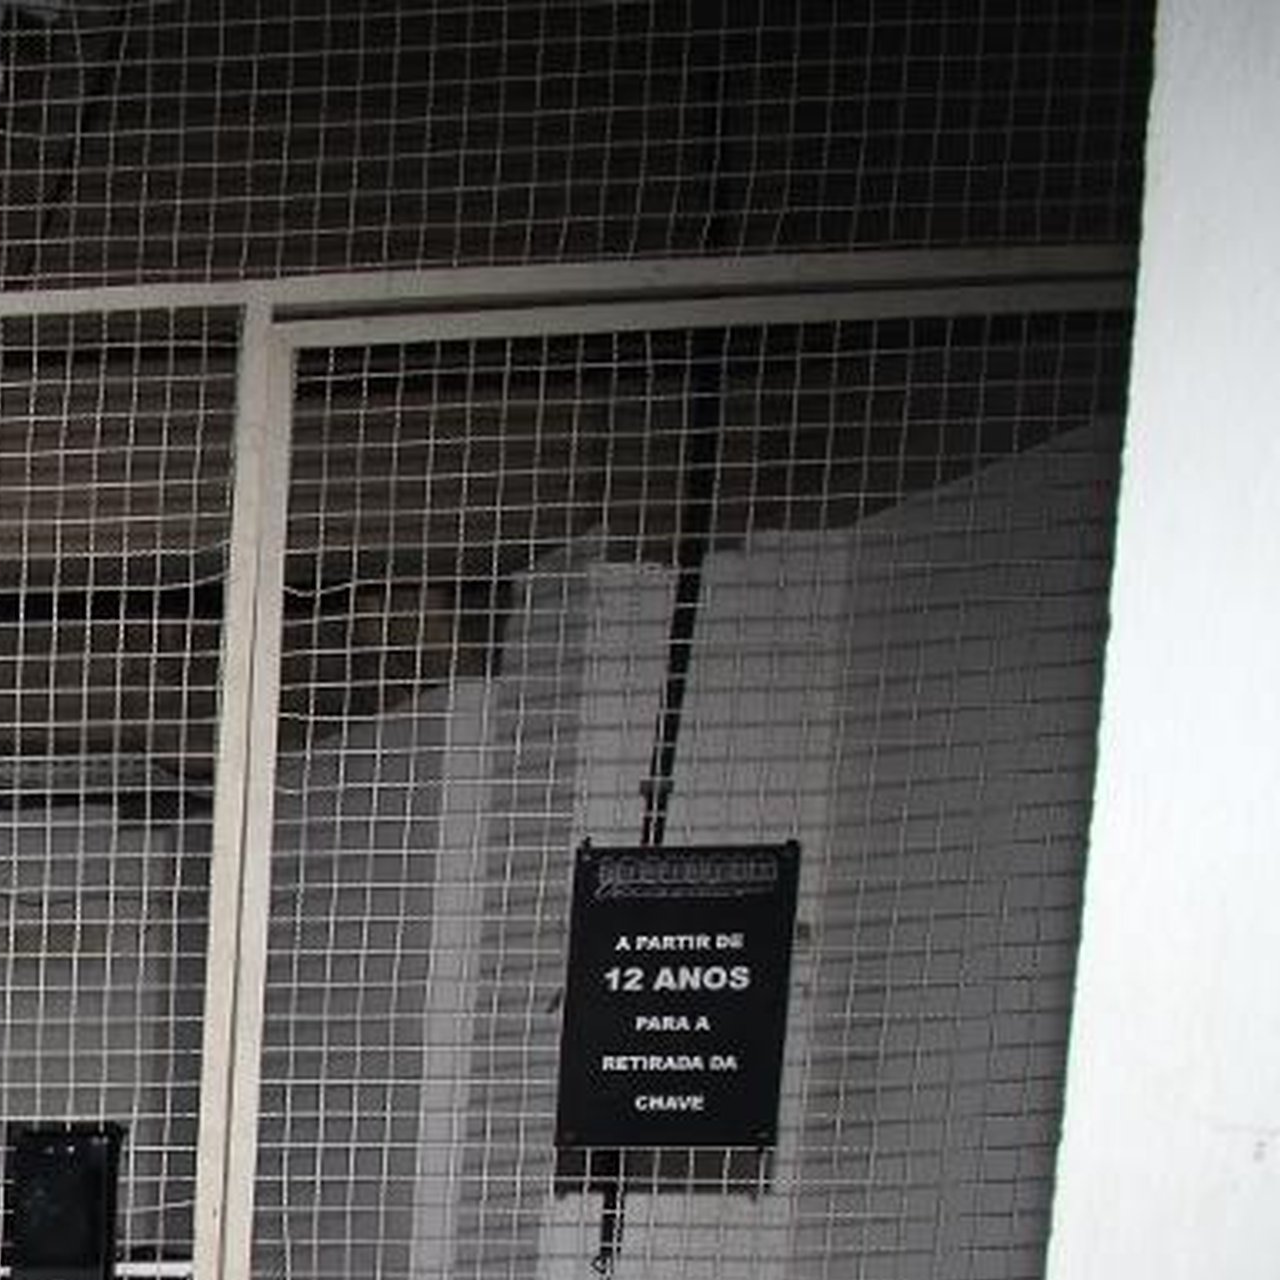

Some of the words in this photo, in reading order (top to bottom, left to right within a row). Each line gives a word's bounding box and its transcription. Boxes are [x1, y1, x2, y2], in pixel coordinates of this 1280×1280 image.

[614, 935, 632, 952] A
[635, 934, 711, 952] PARTIR
[715, 932, 744, 950] DE
[603, 967, 644, 992] 12
[653, 965, 752, 992] ANOS
[634, 1015, 690, 1032] PARA
[693, 1015, 711, 1032] A
[601, 1055, 704, 1072] RETIRADA
[709, 1055, 738, 1071] DA
[634, 1094, 706, 1111] CHAVE
